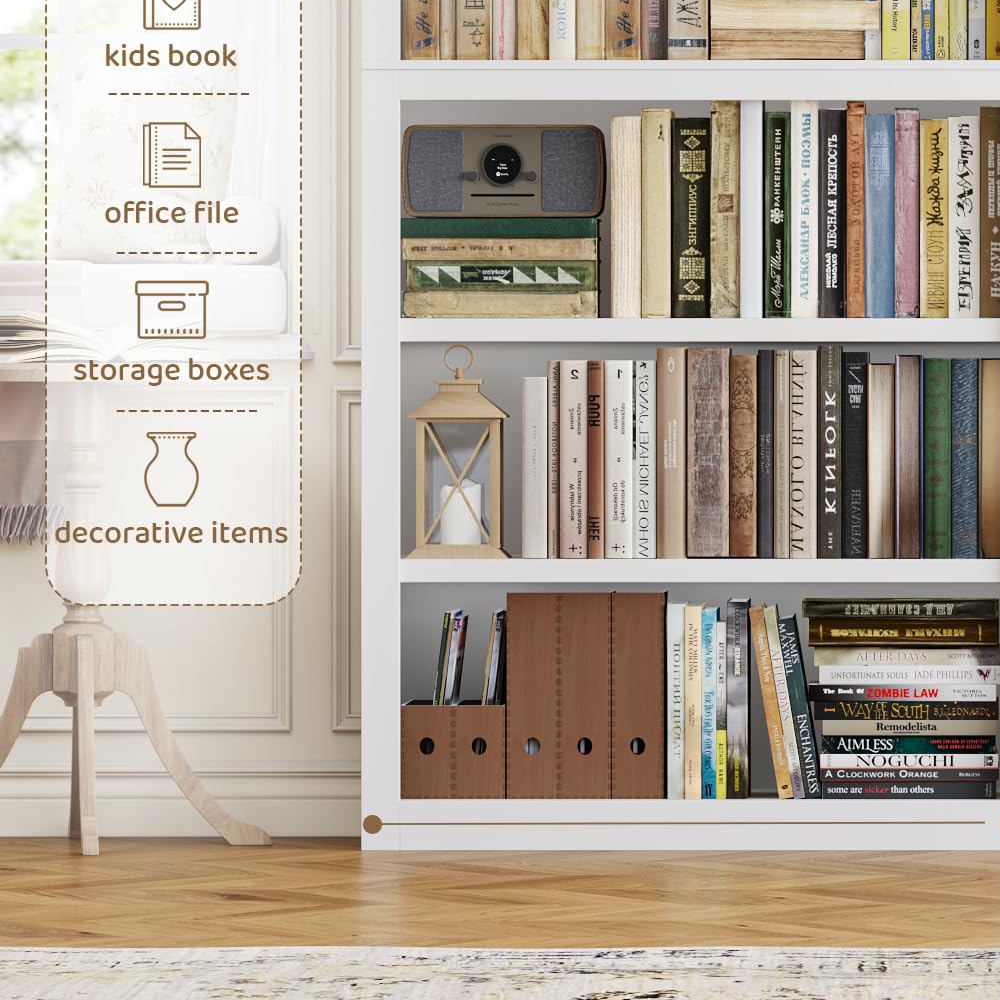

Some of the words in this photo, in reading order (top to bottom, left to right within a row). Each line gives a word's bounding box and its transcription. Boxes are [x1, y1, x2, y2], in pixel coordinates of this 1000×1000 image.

[802, 113, 810, 168] ПОЭМЫ
[828, 135, 837, 195] КРЕПОСТЬ
[801, 179, 809, 215] БЛОК
[828, 200, 837, 248] ЛЕСНАЯ
[799, 221, 809, 300] АЛЕКСАНДР
[779, 623, 793, 676] MAXWELL
[786, 632, 799, 664] JAMES
[856, 652, 896, 661] AFTER
[901, 652, 927, 660] DAYS
[831, 672, 880, 680] UNFORTUNATE
[914, 670, 934, 679] JADE
[938, 670, 972, 679] PHILLIPS
[866, 688, 910, 698] ZOMBIE
[913, 689, 938, 698] LAW
[876, 722, 936, 731] Remodelista
[797, 714, 818, 793] ENCHANTRESS
[837, 738, 892, 752] AIMLESS
[856, 755, 954, 767] NOGUCHI
[864, 785, 889, 793] sicker
